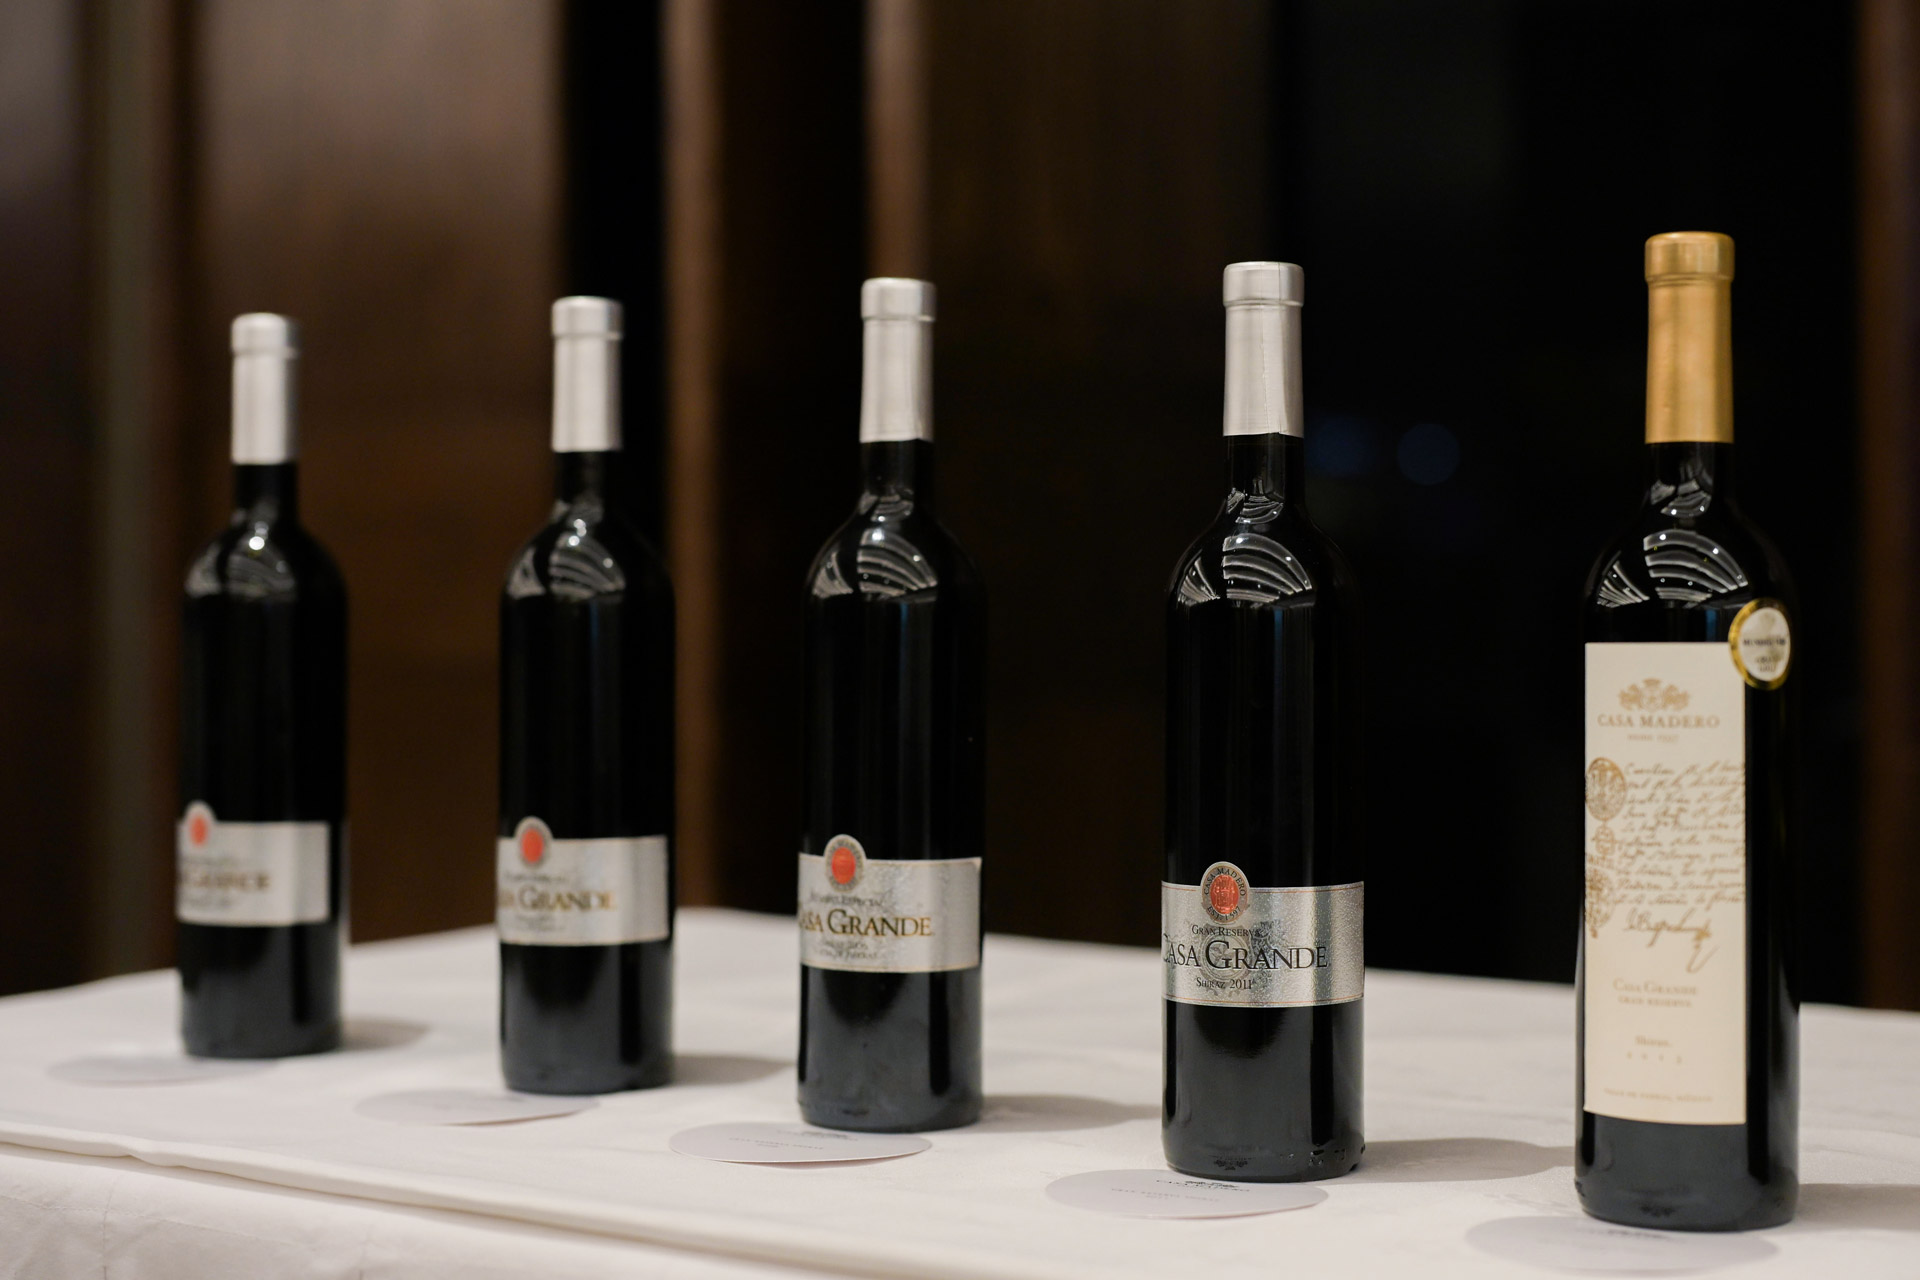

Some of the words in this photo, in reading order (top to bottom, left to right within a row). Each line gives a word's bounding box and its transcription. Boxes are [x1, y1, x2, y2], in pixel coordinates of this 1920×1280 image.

[1597, 714, 1634, 727] CASA
[1639, 715, 1720, 729] MADERO
[1204, 873, 1216, 895] CASA
[1217, 867, 1247, 897] MADERO
[827, 908, 932, 937] GRANDE
[1191, 924, 1217, 936] GRAN
[1162, 932, 1201, 967] CASA
[1205, 939, 1329, 970] GRANDE
